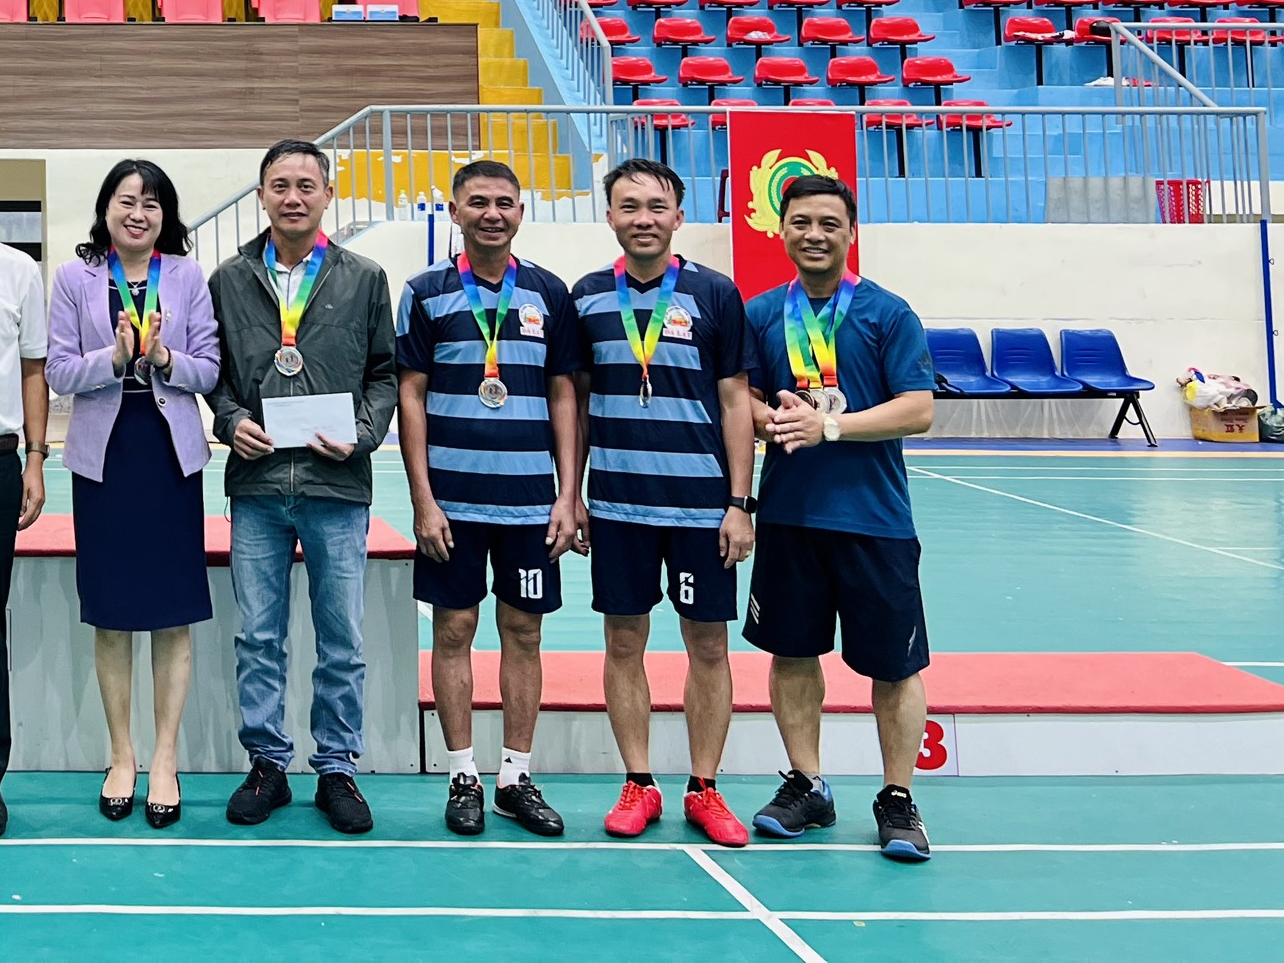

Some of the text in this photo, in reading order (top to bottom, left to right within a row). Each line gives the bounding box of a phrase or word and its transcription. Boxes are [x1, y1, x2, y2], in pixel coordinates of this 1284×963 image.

[518, 568, 543, 599] 10
[679, 572, 694, 604] 6
[915, 720, 948, 770] 3
